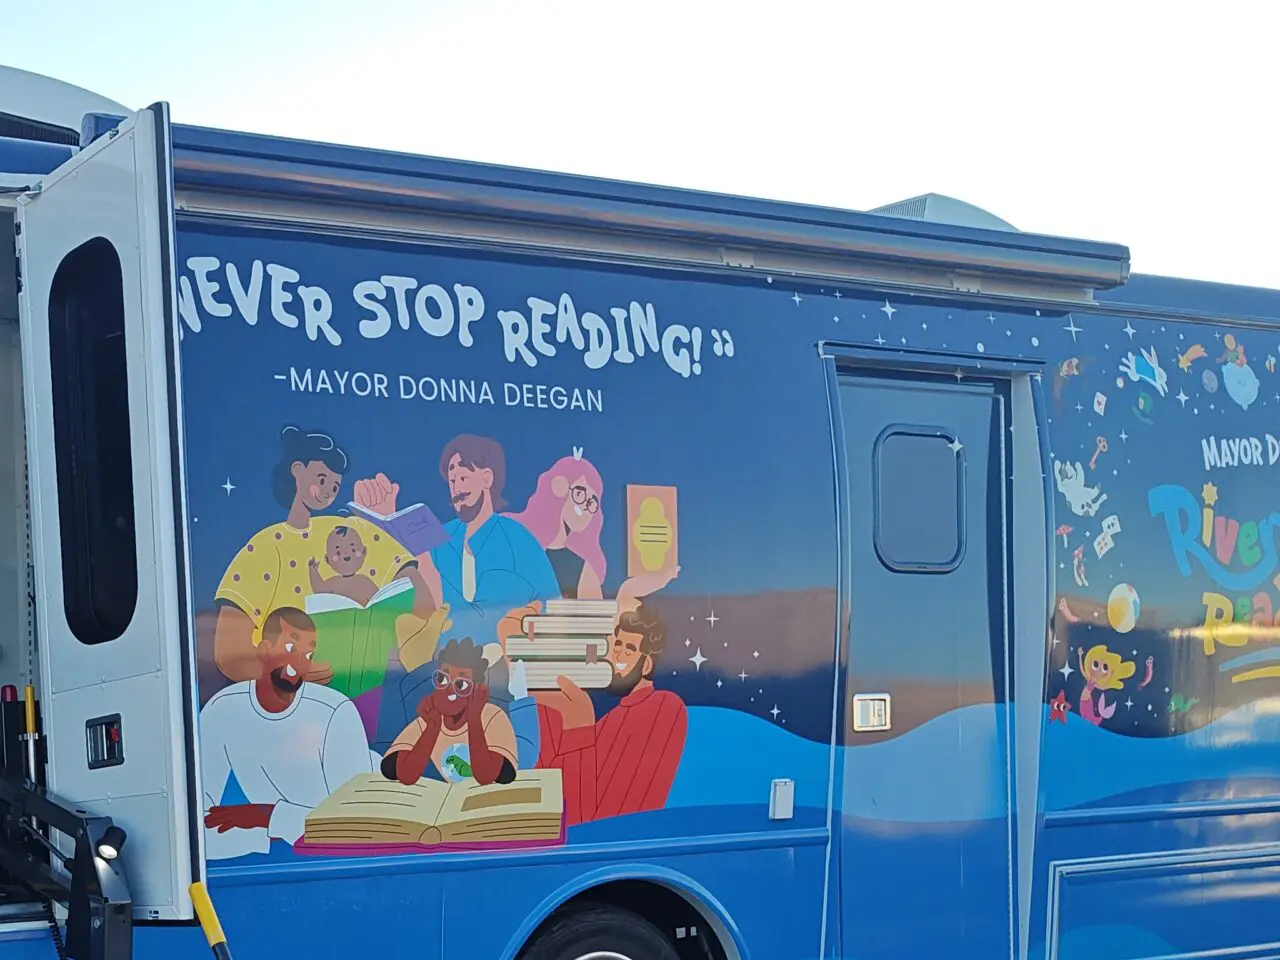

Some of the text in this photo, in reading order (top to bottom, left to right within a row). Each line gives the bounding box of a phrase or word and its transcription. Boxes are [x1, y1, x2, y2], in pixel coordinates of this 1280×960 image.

[352, 275, 485, 347] STOP
[273, 366, 603, 413] -MAYOR DONNA DEEGAN
[1201, 433, 1280, 470] MAYOR D
